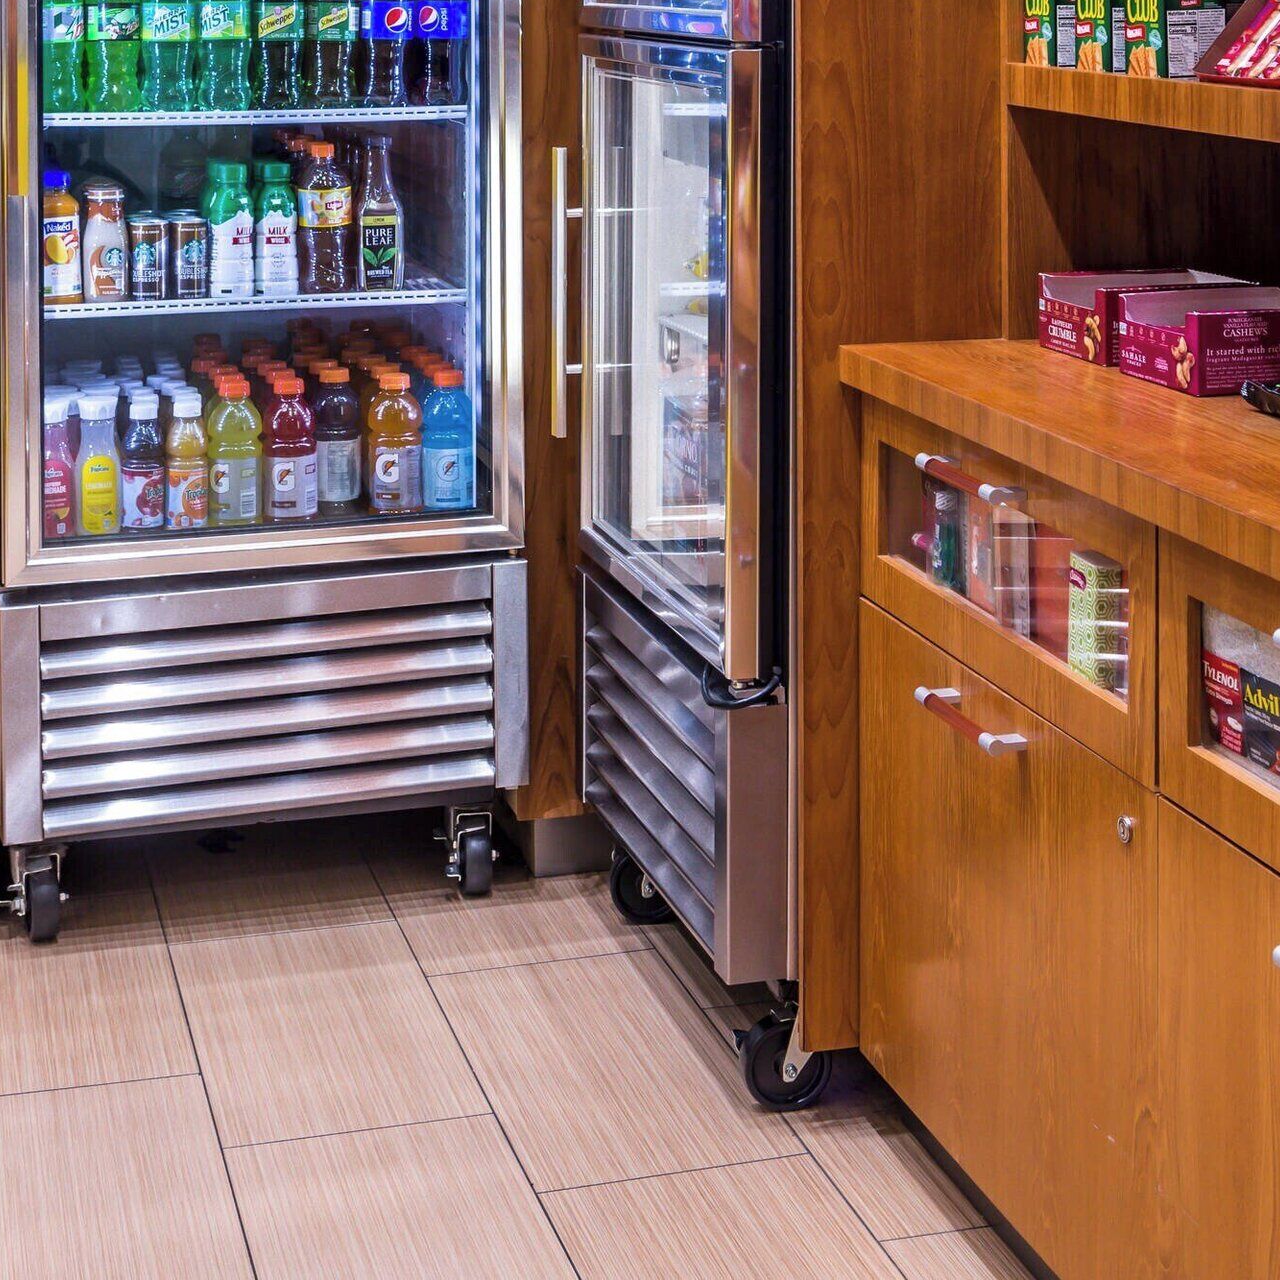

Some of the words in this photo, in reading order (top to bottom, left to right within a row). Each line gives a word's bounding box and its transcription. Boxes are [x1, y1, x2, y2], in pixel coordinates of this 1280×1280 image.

[153, 11, 188, 33] MIST
[200, 11, 230, 32] MIST
[259, 9, 295, 35] Schweppes
[440, 6, 449, 31] pepsi
[268, 226, 288, 236] MILK
[365, 228, 394, 238] PURE
[365, 237, 394, 246] LEAF
[1048, 324, 1077, 343] CRUMBLE
[1222, 327, 1269, 338] CASHEWS
[1121, 349, 1147, 364] SAHALE
[1206, 348, 1213, 357] It
[1216, 346, 1245, 356] started
[1247, 344, 1266, 355] with
[1202, 659, 1240, 692] TYLENOL
[1215, 691, 1234, 707] Strength
